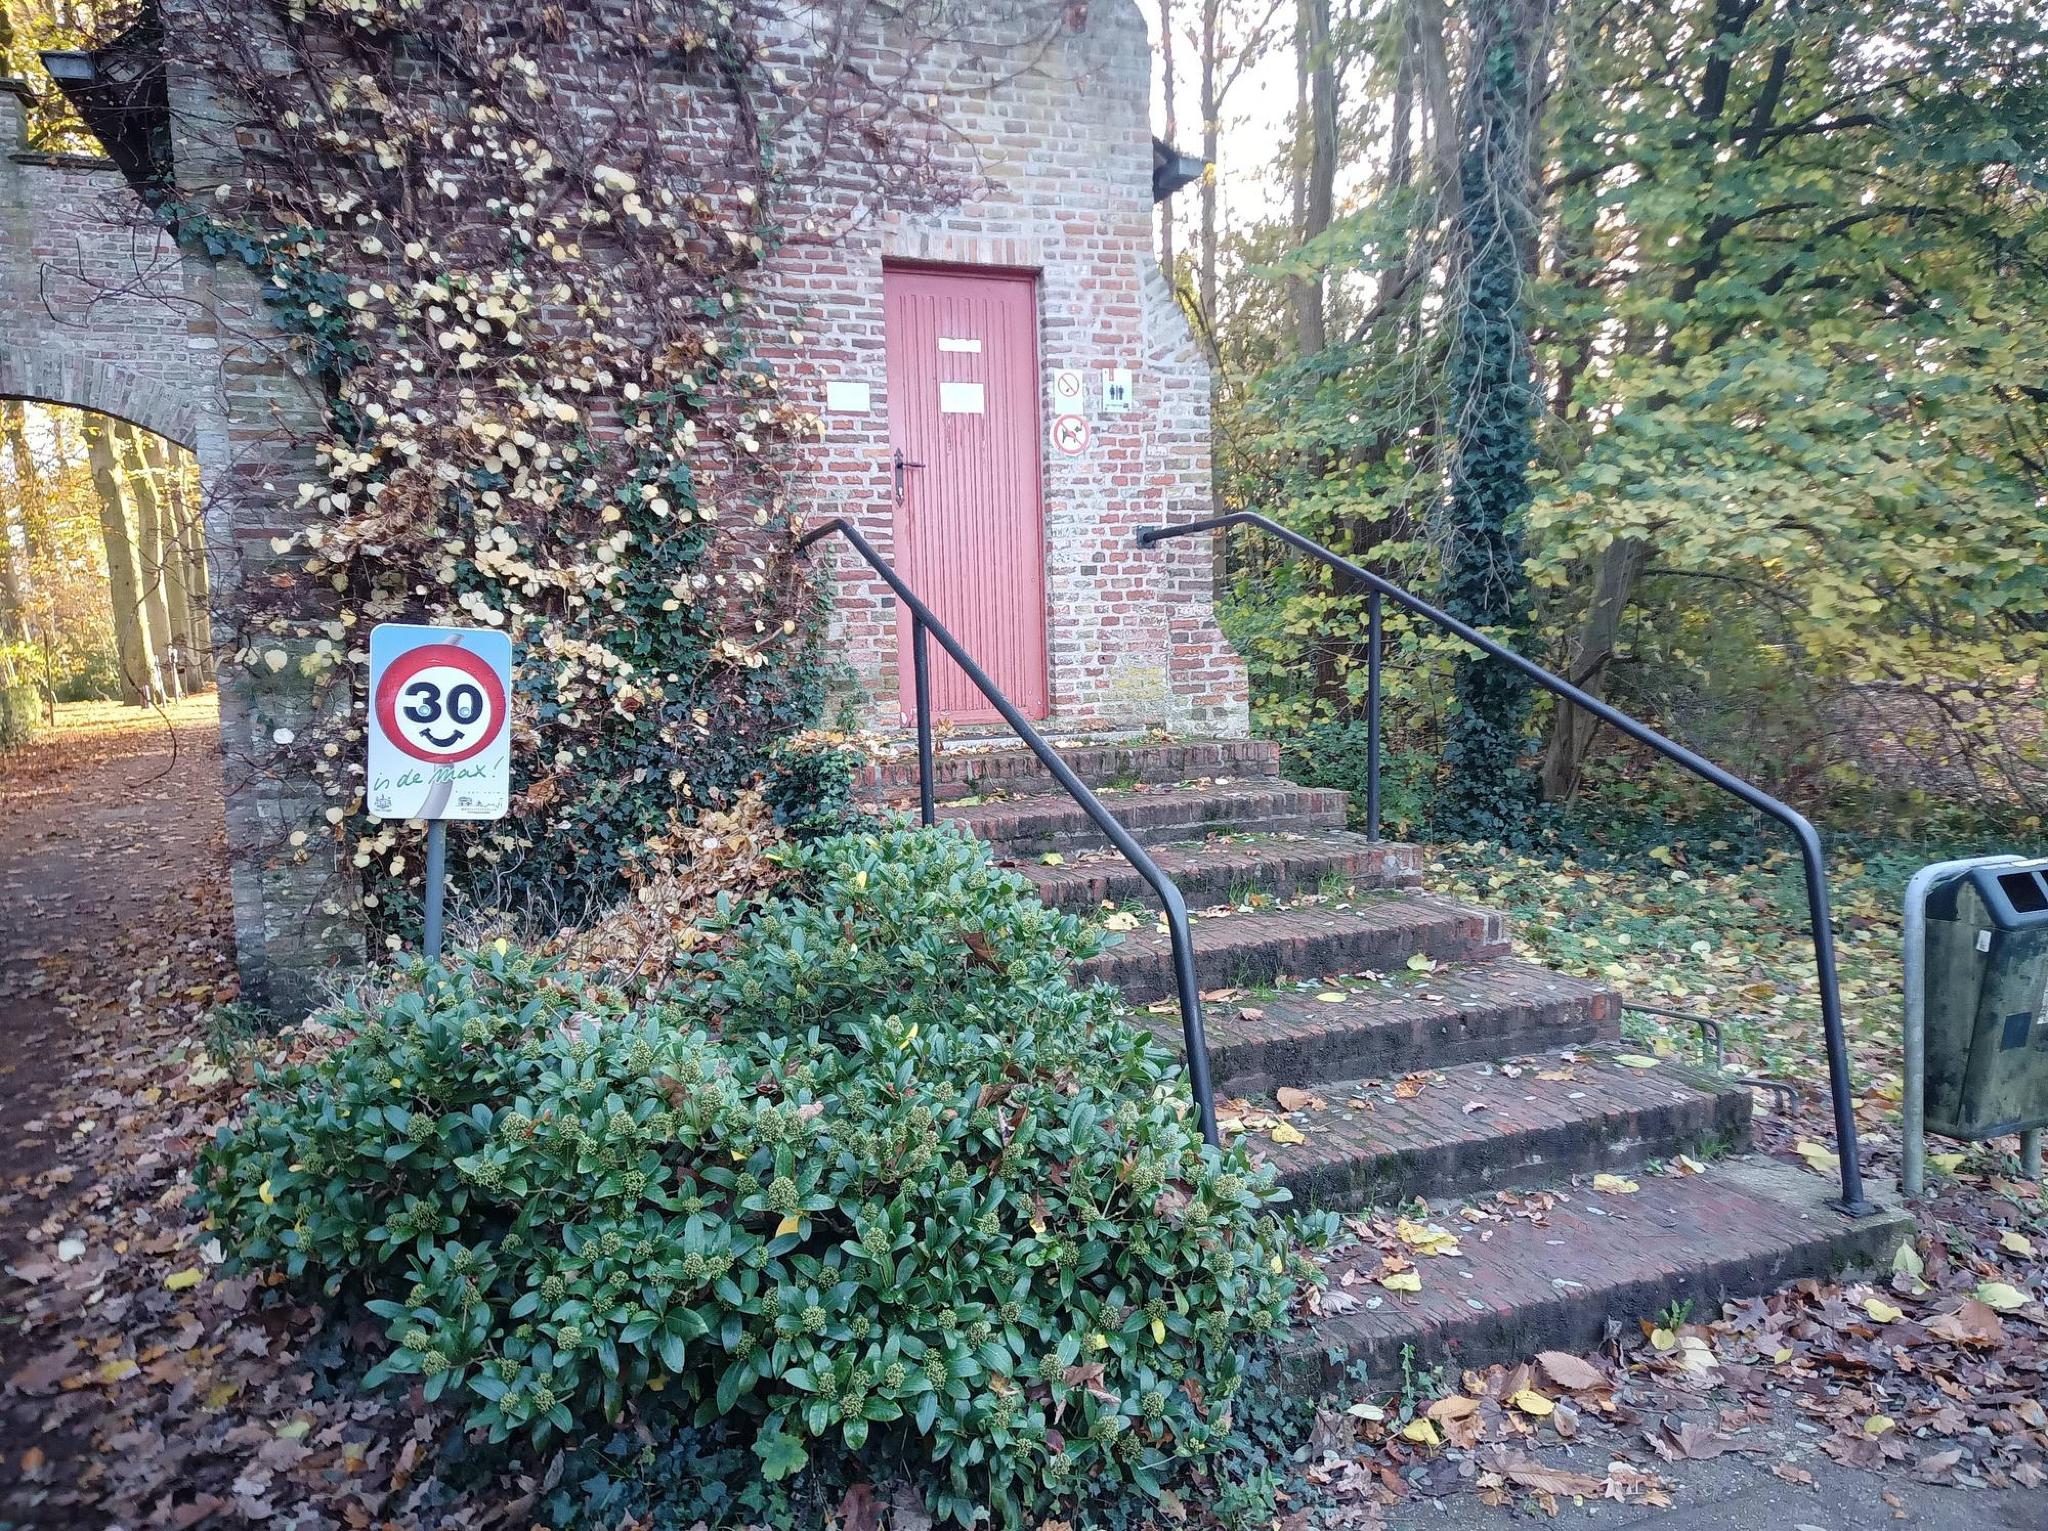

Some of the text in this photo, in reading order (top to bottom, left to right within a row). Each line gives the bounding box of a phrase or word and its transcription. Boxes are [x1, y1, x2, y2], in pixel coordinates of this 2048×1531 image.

[403, 682, 483, 725] 30
[374, 756, 504, 791] is de max!
